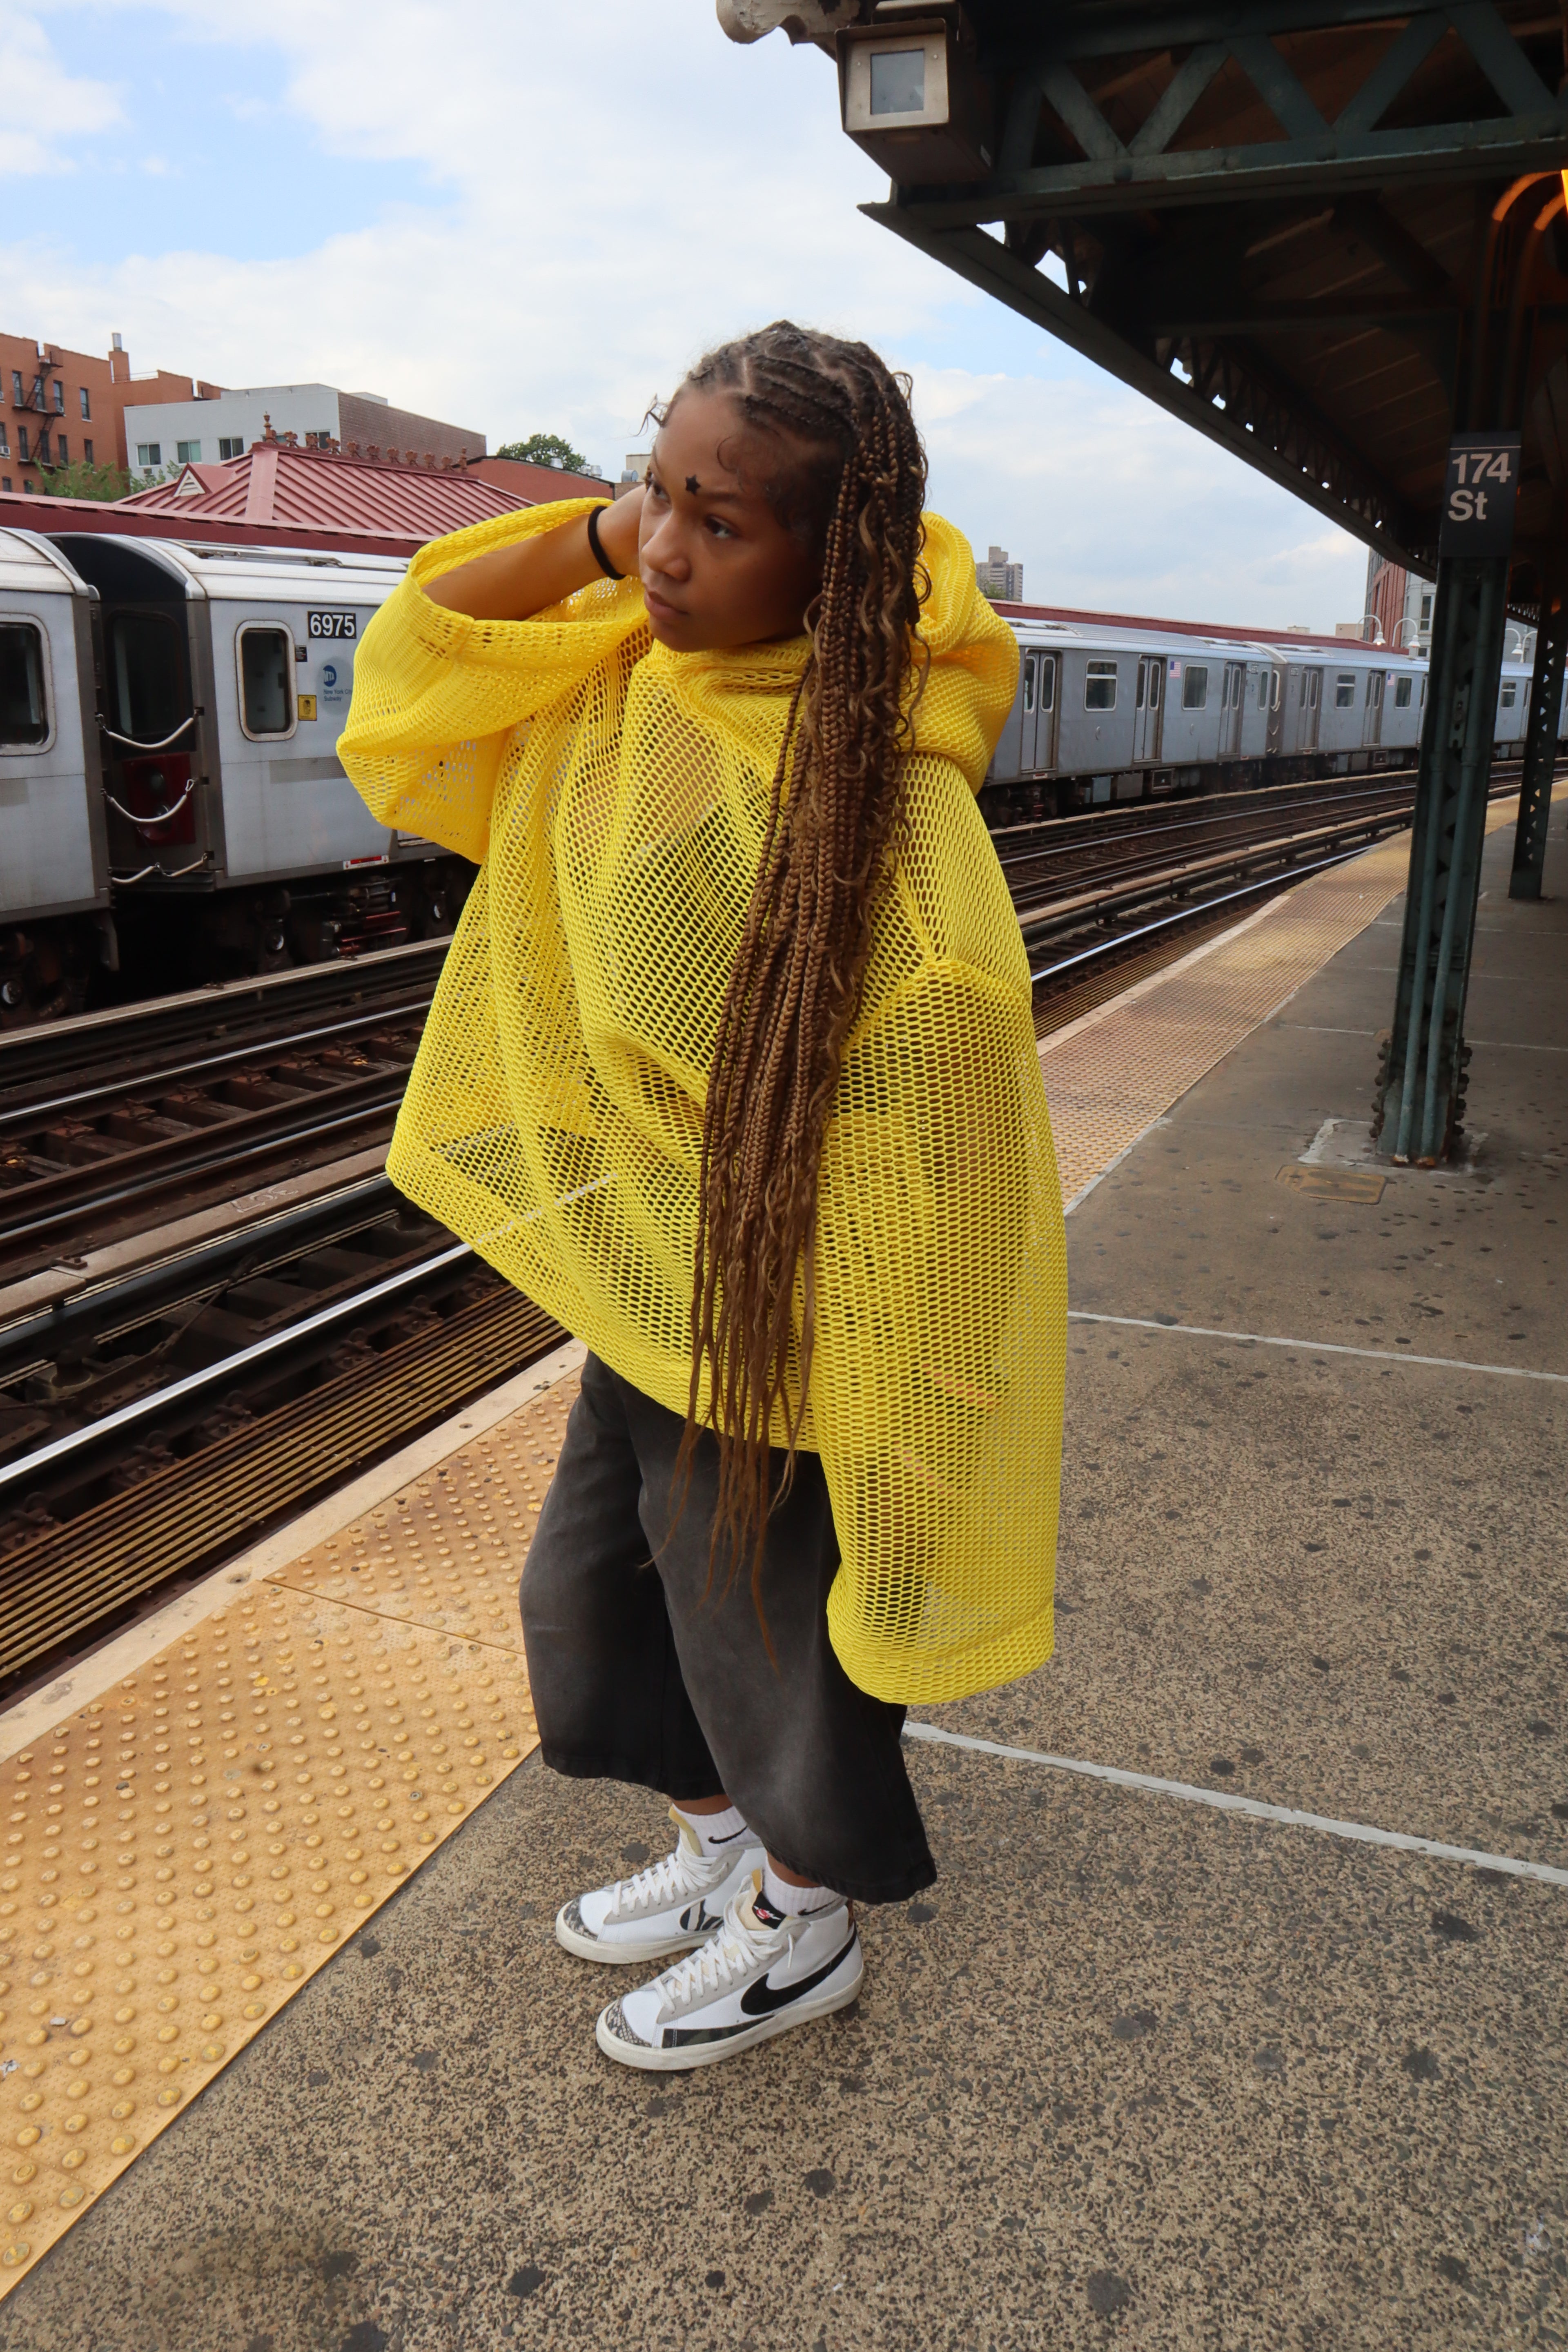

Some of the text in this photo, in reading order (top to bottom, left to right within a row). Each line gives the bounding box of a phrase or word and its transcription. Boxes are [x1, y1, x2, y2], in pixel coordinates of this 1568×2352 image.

[1452, 452, 1511, 484] 174
[1448, 490, 1488, 521] St
[310, 614, 355, 637] 6975
